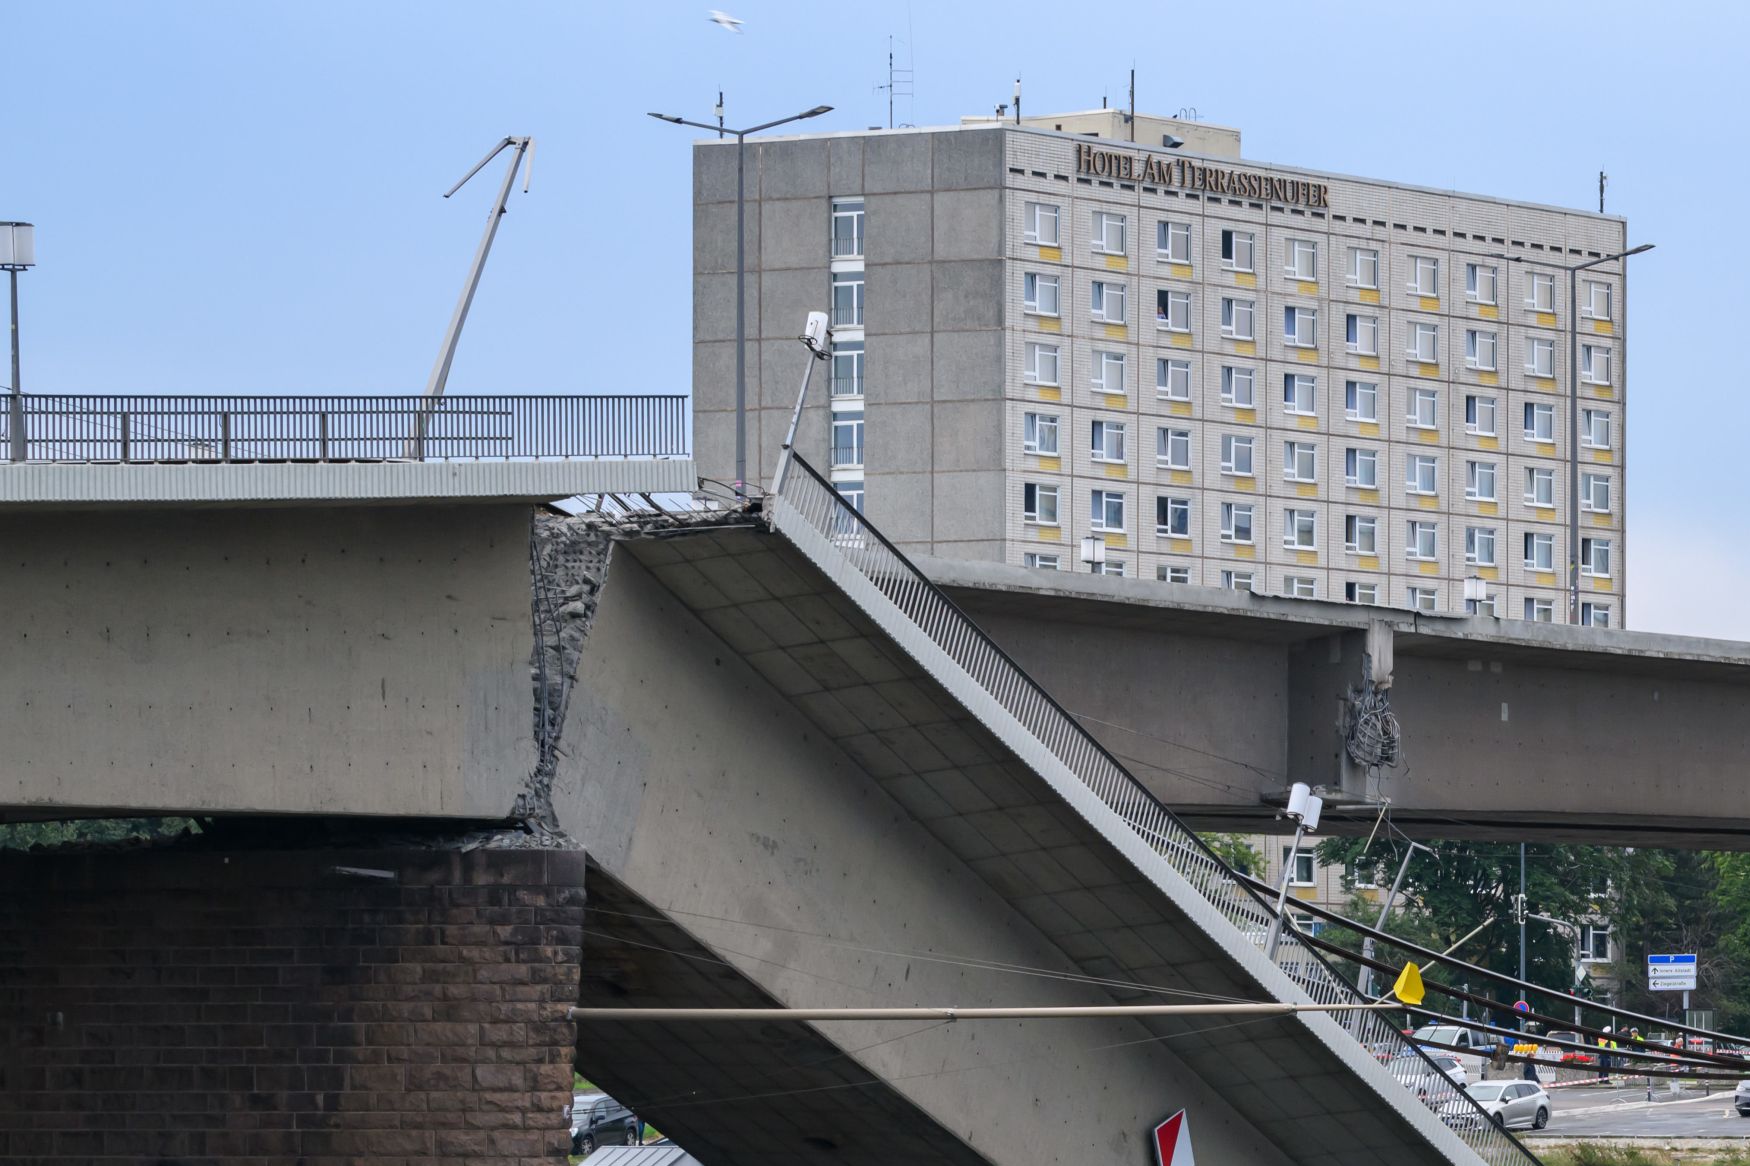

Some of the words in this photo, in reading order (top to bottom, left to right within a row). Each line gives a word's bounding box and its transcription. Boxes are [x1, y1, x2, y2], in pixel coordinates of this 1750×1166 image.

[1077, 143, 1141, 181] HOTEL
[1140, 154, 1173, 185] AM
[1176, 158, 1329, 208] TERRASSENUFER
[1669, 955, 1675, 963] P
